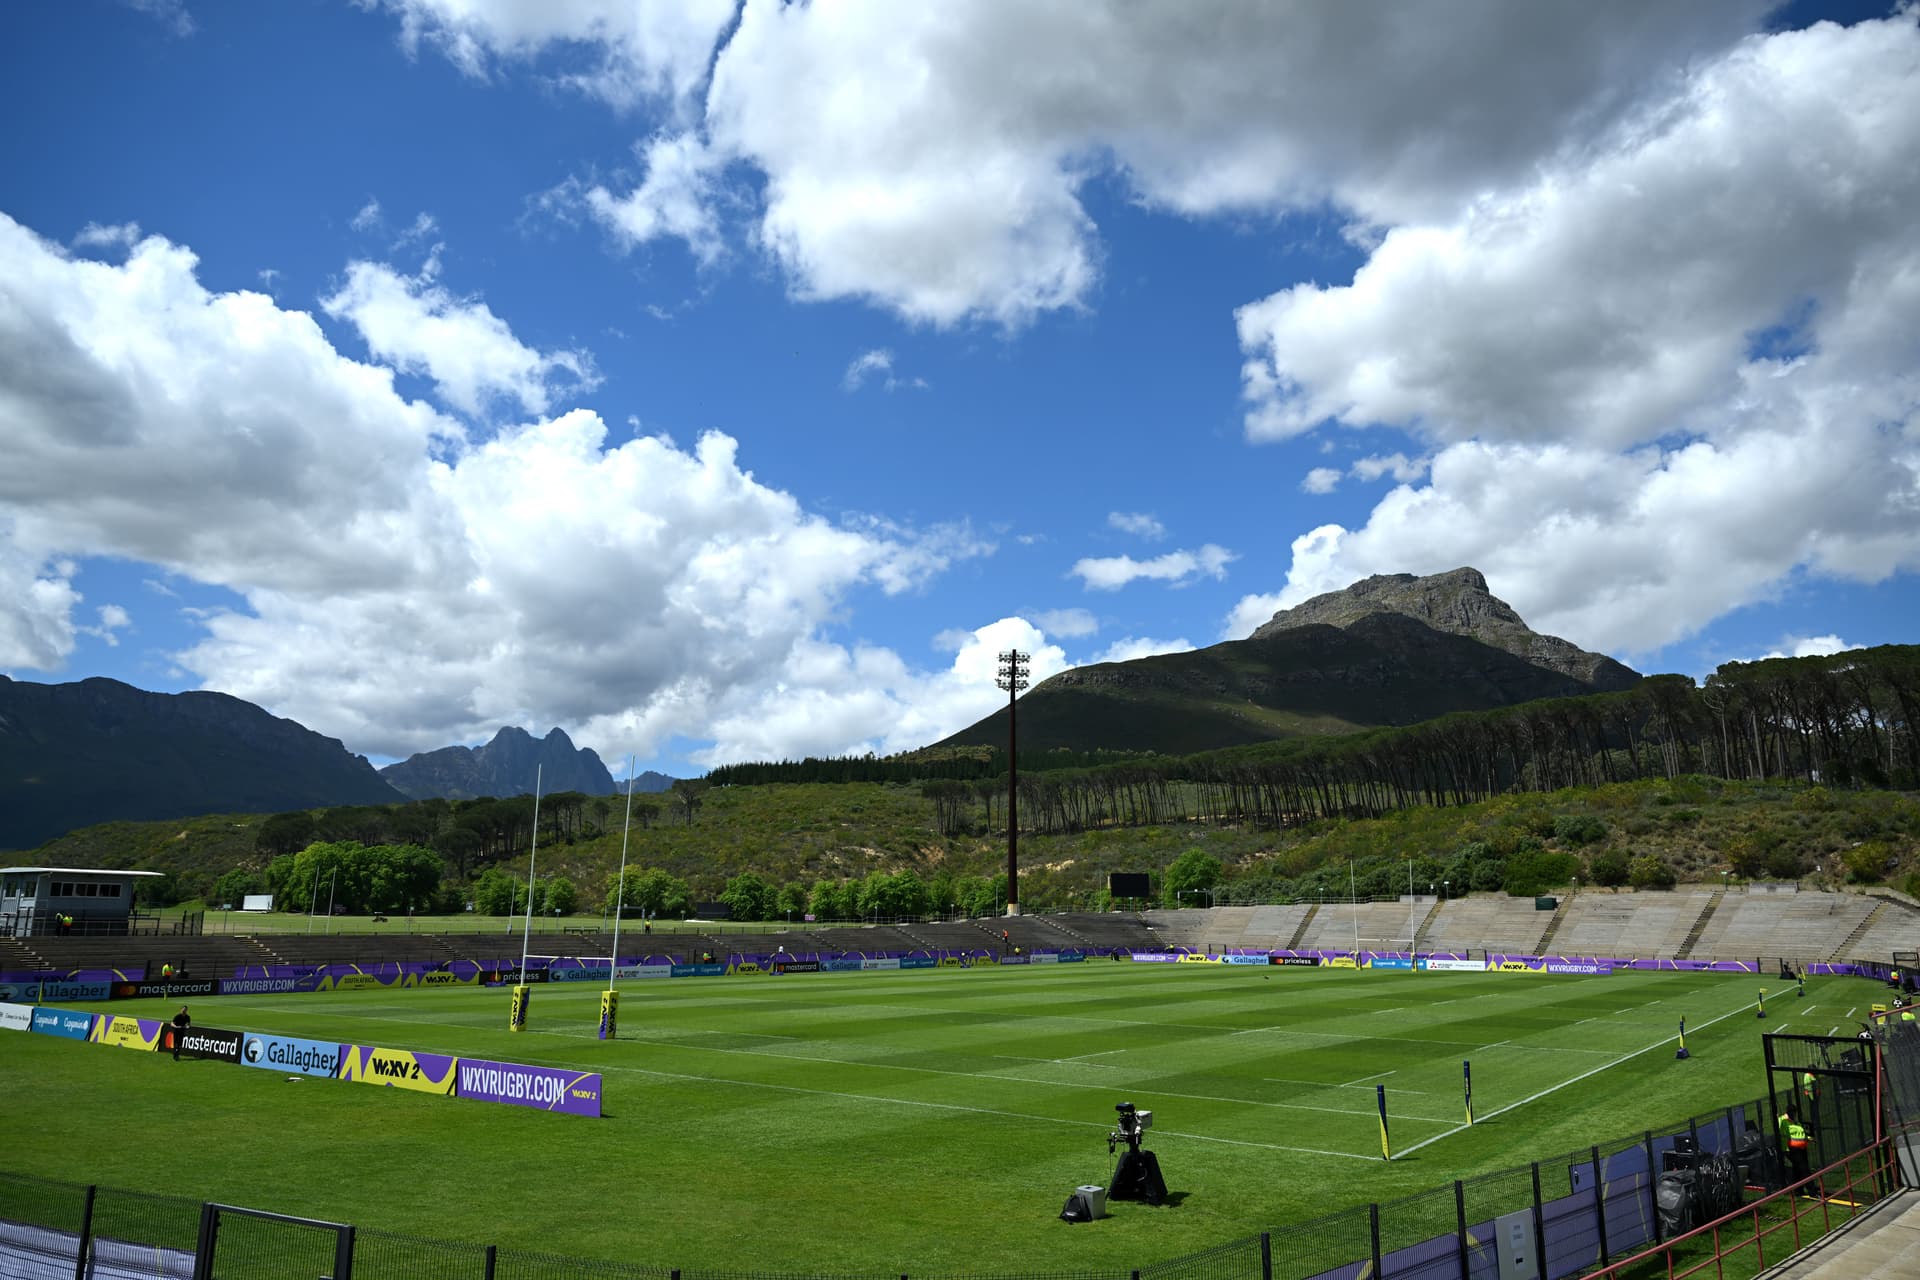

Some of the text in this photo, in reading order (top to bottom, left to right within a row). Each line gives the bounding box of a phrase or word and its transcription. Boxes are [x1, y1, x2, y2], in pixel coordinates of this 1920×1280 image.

[1234, 956, 1267, 964] Gallagher
[785, 963, 817, 971] mastercard
[1548, 964, 1597, 973] WXVRUGBY.COM
[139, 982, 212, 994] mastercard
[223, 979, 295, 993] WXVRUGBY.COM
[267, 1042, 336, 1072] Gallagher
[372, 1058, 420, 1080] WXV 2
[462, 1066, 565, 1105] WXVRUGBY.COM
